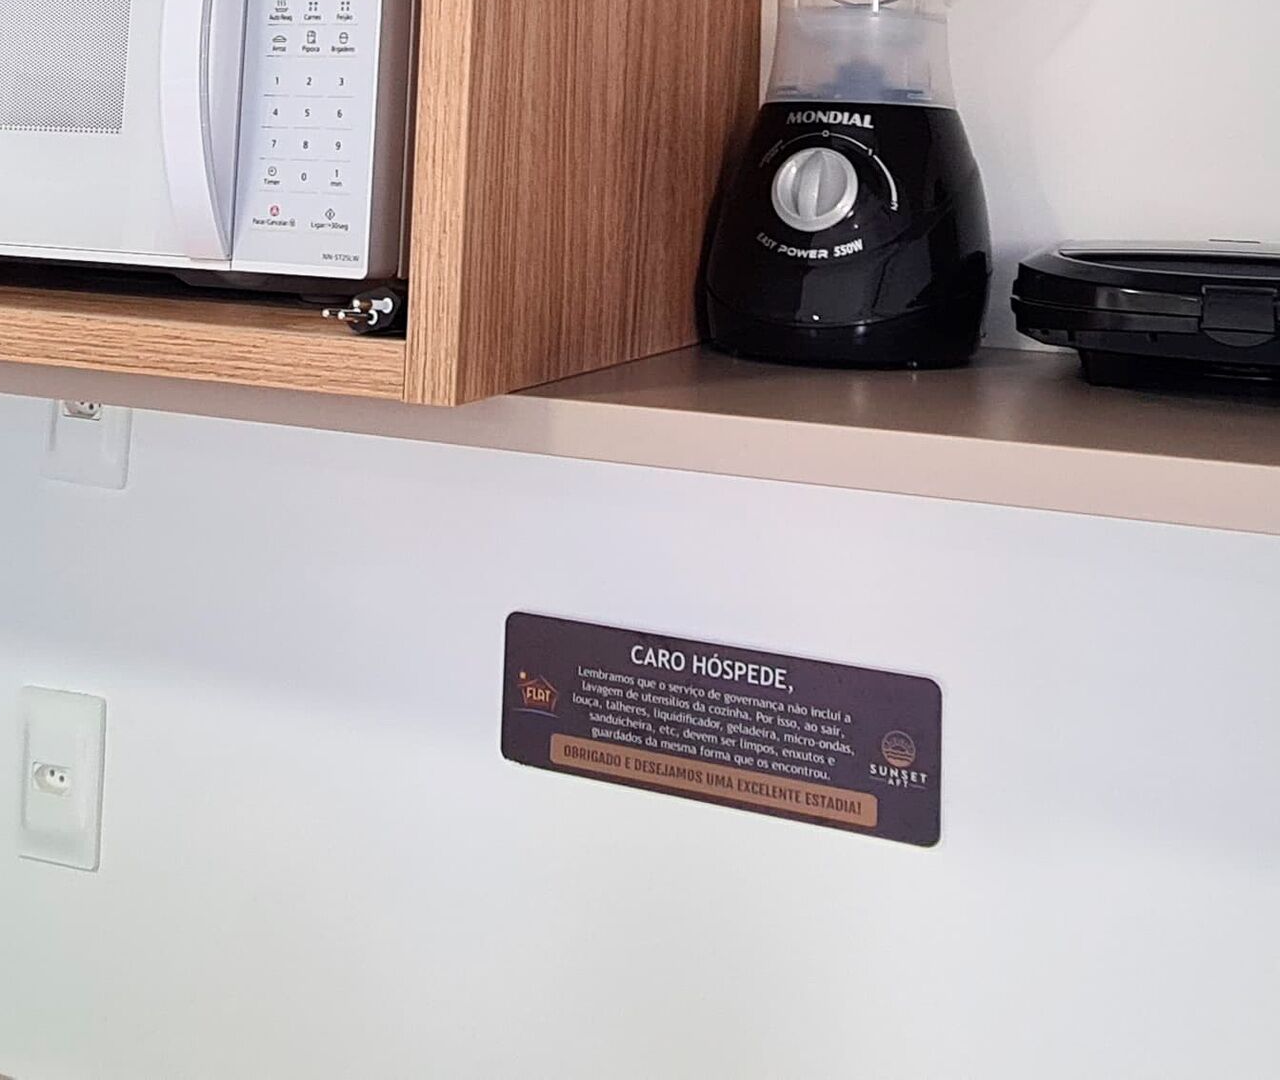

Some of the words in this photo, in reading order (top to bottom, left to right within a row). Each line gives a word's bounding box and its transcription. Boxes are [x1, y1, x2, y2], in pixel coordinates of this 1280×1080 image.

[275, 77, 279, 85] 1
[306, 77, 312, 86] 2
[339, 77, 344, 86] 3
[272, 108, 278, 116] 4
[305, 109, 310, 117] 5
[337, 109, 343, 118] 6
[786, 110, 874, 129] MONDIAL
[272, 139, 277, 148] 7
[303, 140, 308, 149] 8
[335, 141, 341, 150] 9
[301, 173, 307, 181] 0
[778, 244, 829, 259] POWER
[833, 238, 863, 258] 550W
[631, 645, 685, 671] CARO
[693, 653, 793, 693] HÓSPEDE,
[526, 686, 551, 703] FLAT
[578, 666, 634, 685] Lembramos
[637, 678, 656, 689] que
[659, 682, 666, 690] o
[669, 683, 705, 698] serviço
[708, 689, 721, 700] de
[724, 693, 784, 711] governança
[787, 701, 808, 716] não
[811, 706, 841, 722] inclui
[844, 713, 851, 724] a
[582, 680, 623, 697] lavagem
[626, 689, 639, 700] de
[693, 701, 705, 712] da
[709, 705, 752, 721] cozinha.
[756, 711, 774, 724] Por
[777, 713, 800, 731] isso,
[804, 721, 818, 733] ao
[821, 722, 845, 739] sair,
[572, 692, 602, 709] louça,
[606, 700, 650, 718] talheres,
[653, 707, 723, 731] liquidificador,
[727, 723, 780, 742] geladeira,
[784, 733, 855, 756] micro-ondas,
[589, 713, 656, 733] sanduicheira,
[683, 729, 717, 743] devem
[721, 737, 736, 747] ser
[740, 738, 779, 756] limpos,
[782, 749, 824, 765] enxutos
[828, 756, 835, 766] e
[591, 727, 642, 744] guardados
[645, 736, 657, 747] da
[661, 740, 697, 754] mesma
[700, 745, 731, 761] forma
[734, 754, 754, 767] que
[756, 759, 769, 769] os
[771, 761, 831, 780] encontrou.
[564, 744, 621, 768] OBRIGADO
[625, 757, 631, 769] E
[634, 758, 703, 784] DESEJAMOS
[706, 771, 733, 789] UMA
[737, 778, 801, 804] EXCELENTE
[805, 792, 862, 815] ESTADIA!
[870, 764, 928, 784] SUNSET
